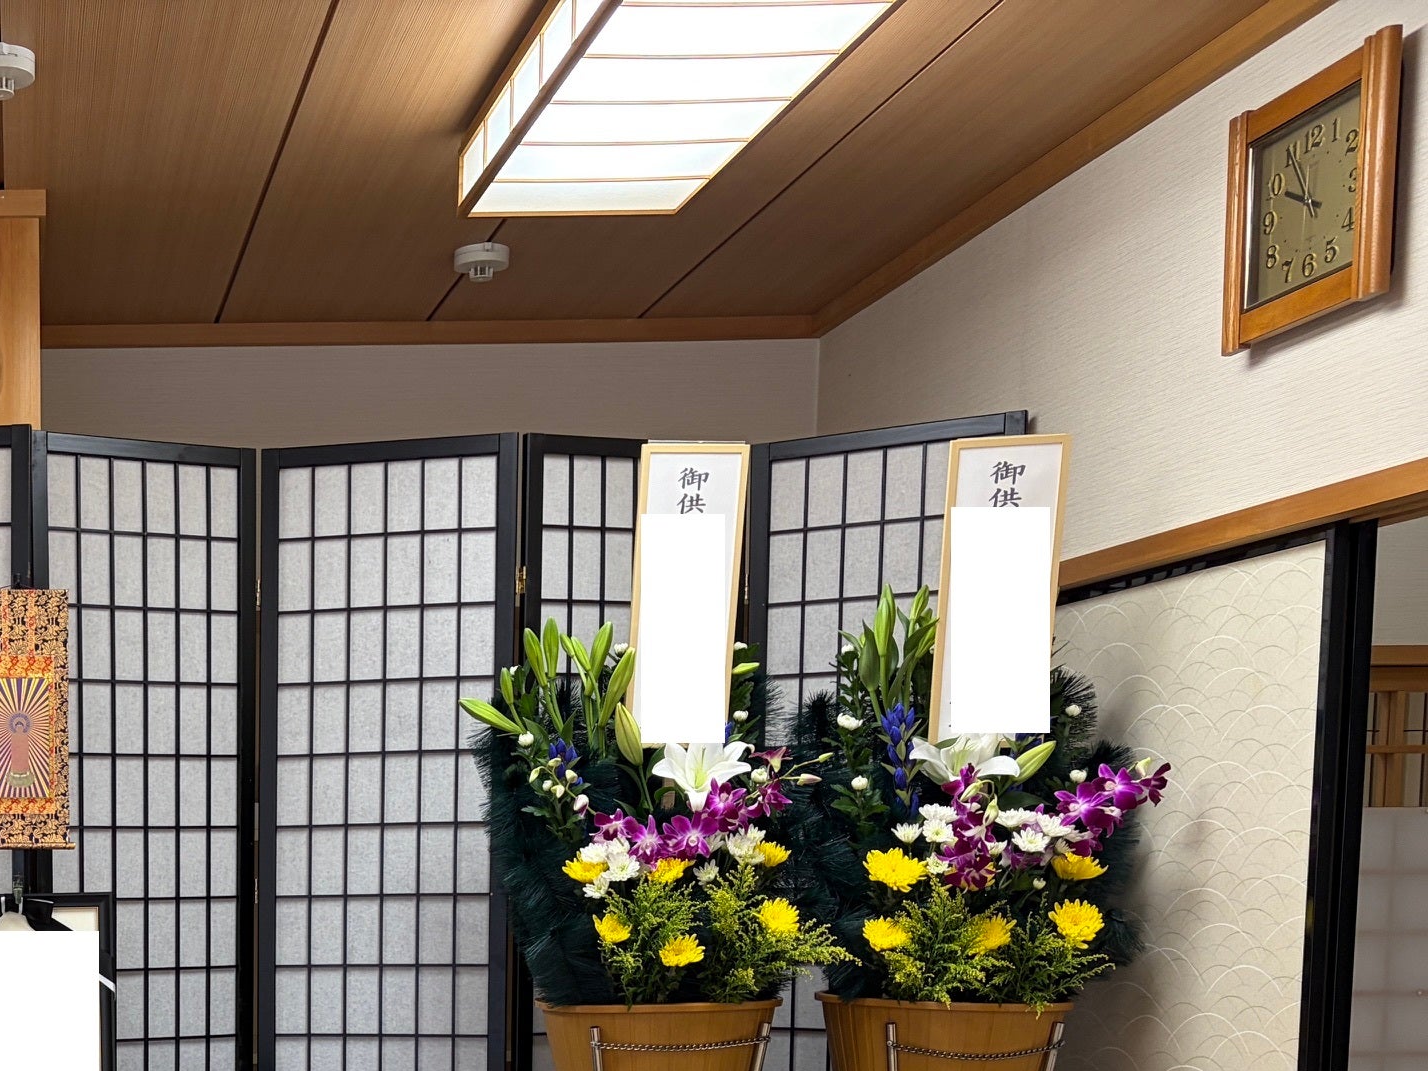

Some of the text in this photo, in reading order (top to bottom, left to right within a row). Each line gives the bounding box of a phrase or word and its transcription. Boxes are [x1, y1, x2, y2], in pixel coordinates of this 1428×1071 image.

[1304, 124, 1325, 154] 12
[1345, 128, 1359, 156] 2
[1263, 211, 1276, 235] 9
[1341, 206, 1354, 232] 4
[1266, 245, 1278, 269] 8
[1324, 236, 1338, 263] 5
[1282, 258, 1293, 283] 7
[1302, 253, 1316, 278] 6
[676, 467, 709, 515] 御供
[988, 460, 1026, 508] 御供
